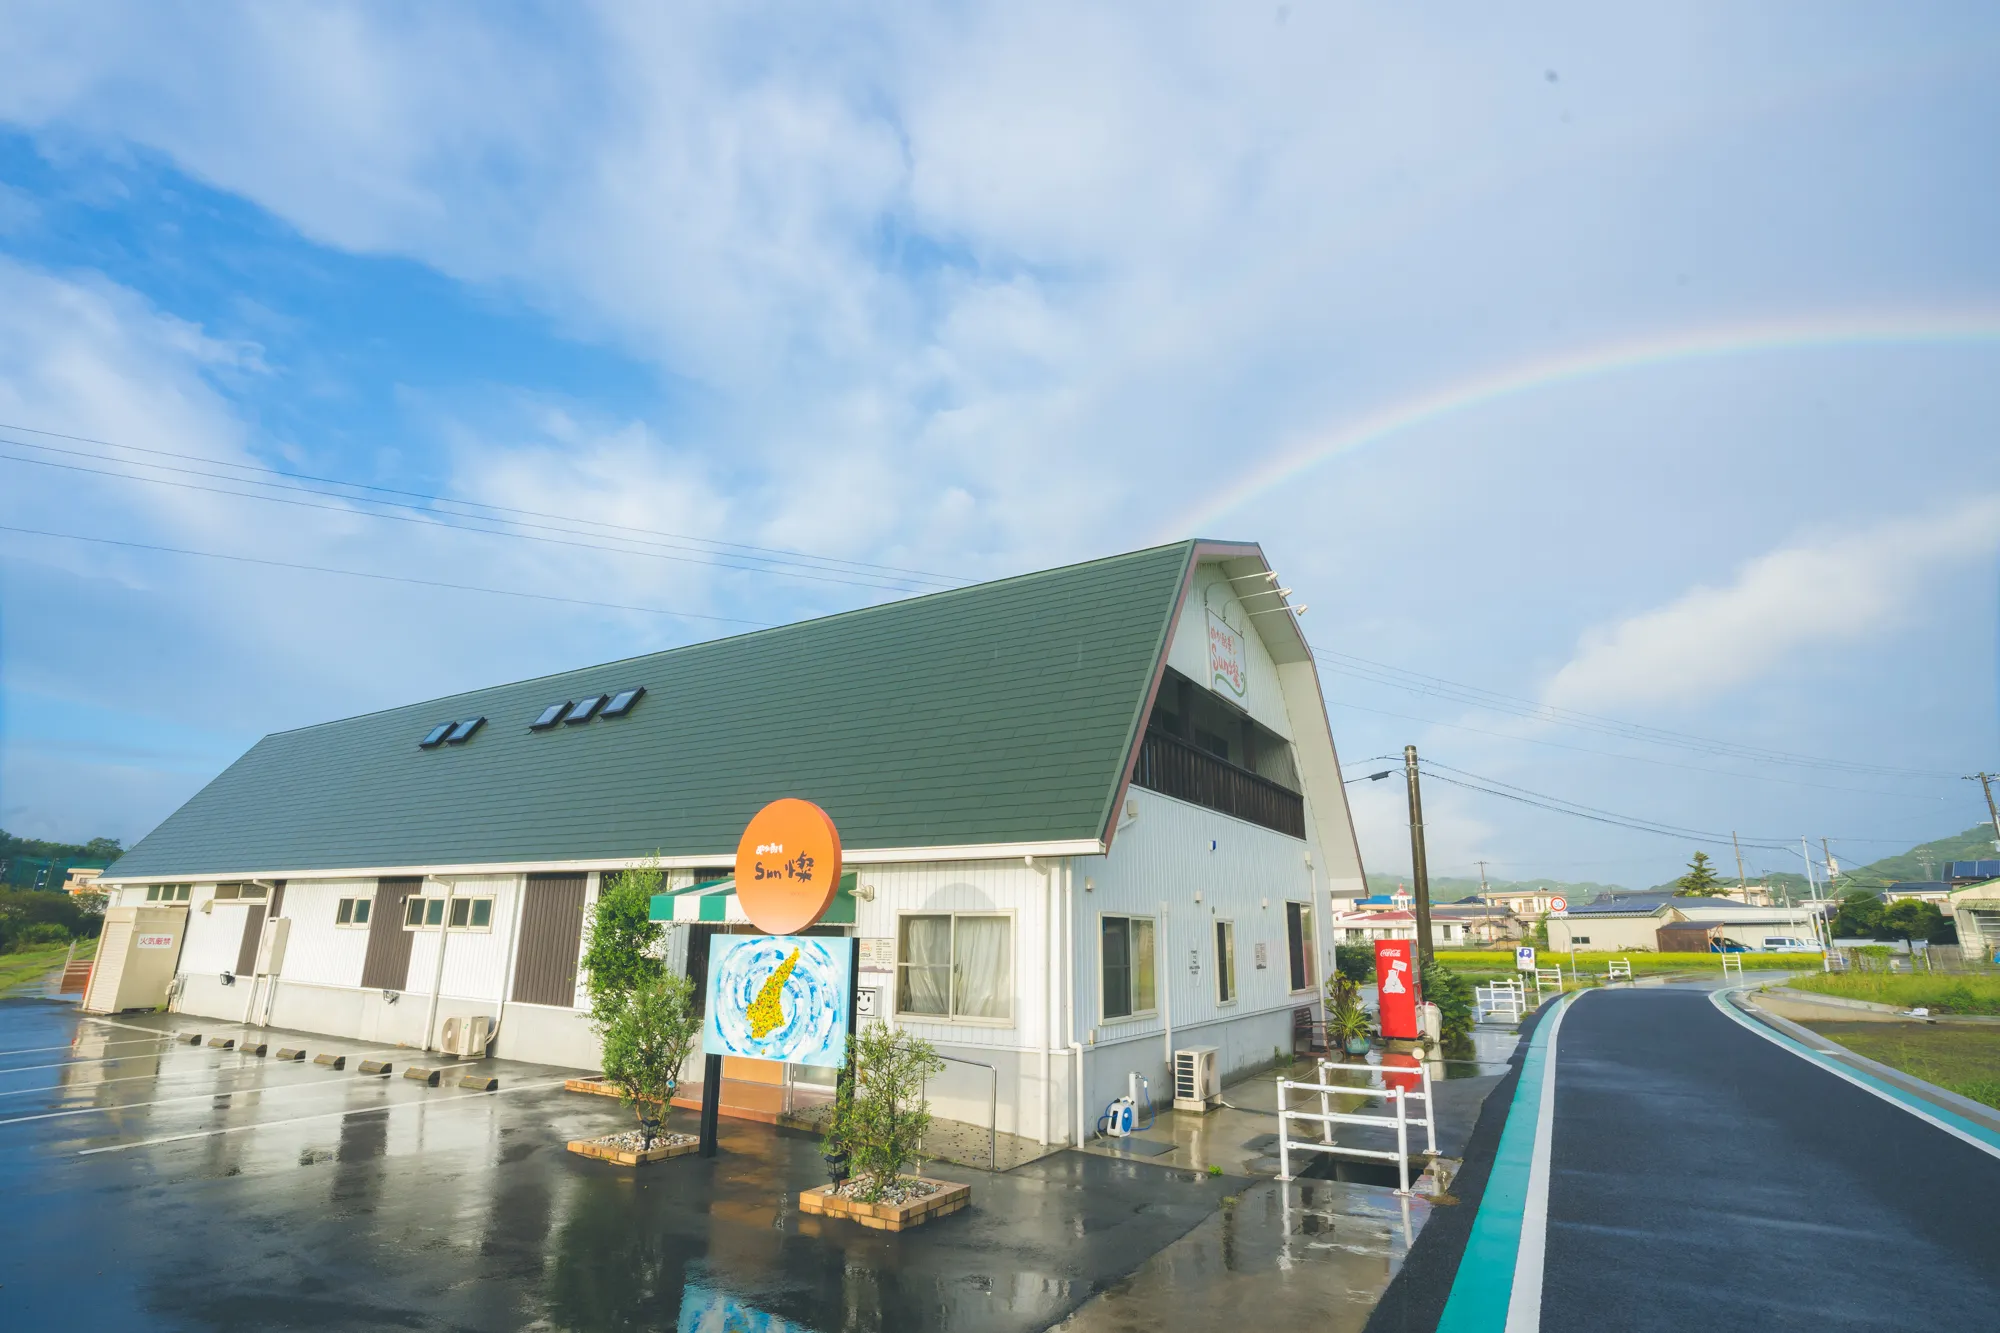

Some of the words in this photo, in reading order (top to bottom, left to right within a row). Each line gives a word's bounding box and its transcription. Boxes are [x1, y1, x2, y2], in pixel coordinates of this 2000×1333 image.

[1554, 900, 1563, 908] 30
[140, 937, 171, 945] 火気厳禁
[1380, 949, 1401, 957] Coca-Cola
[1523, 949, 1530, 957] P
